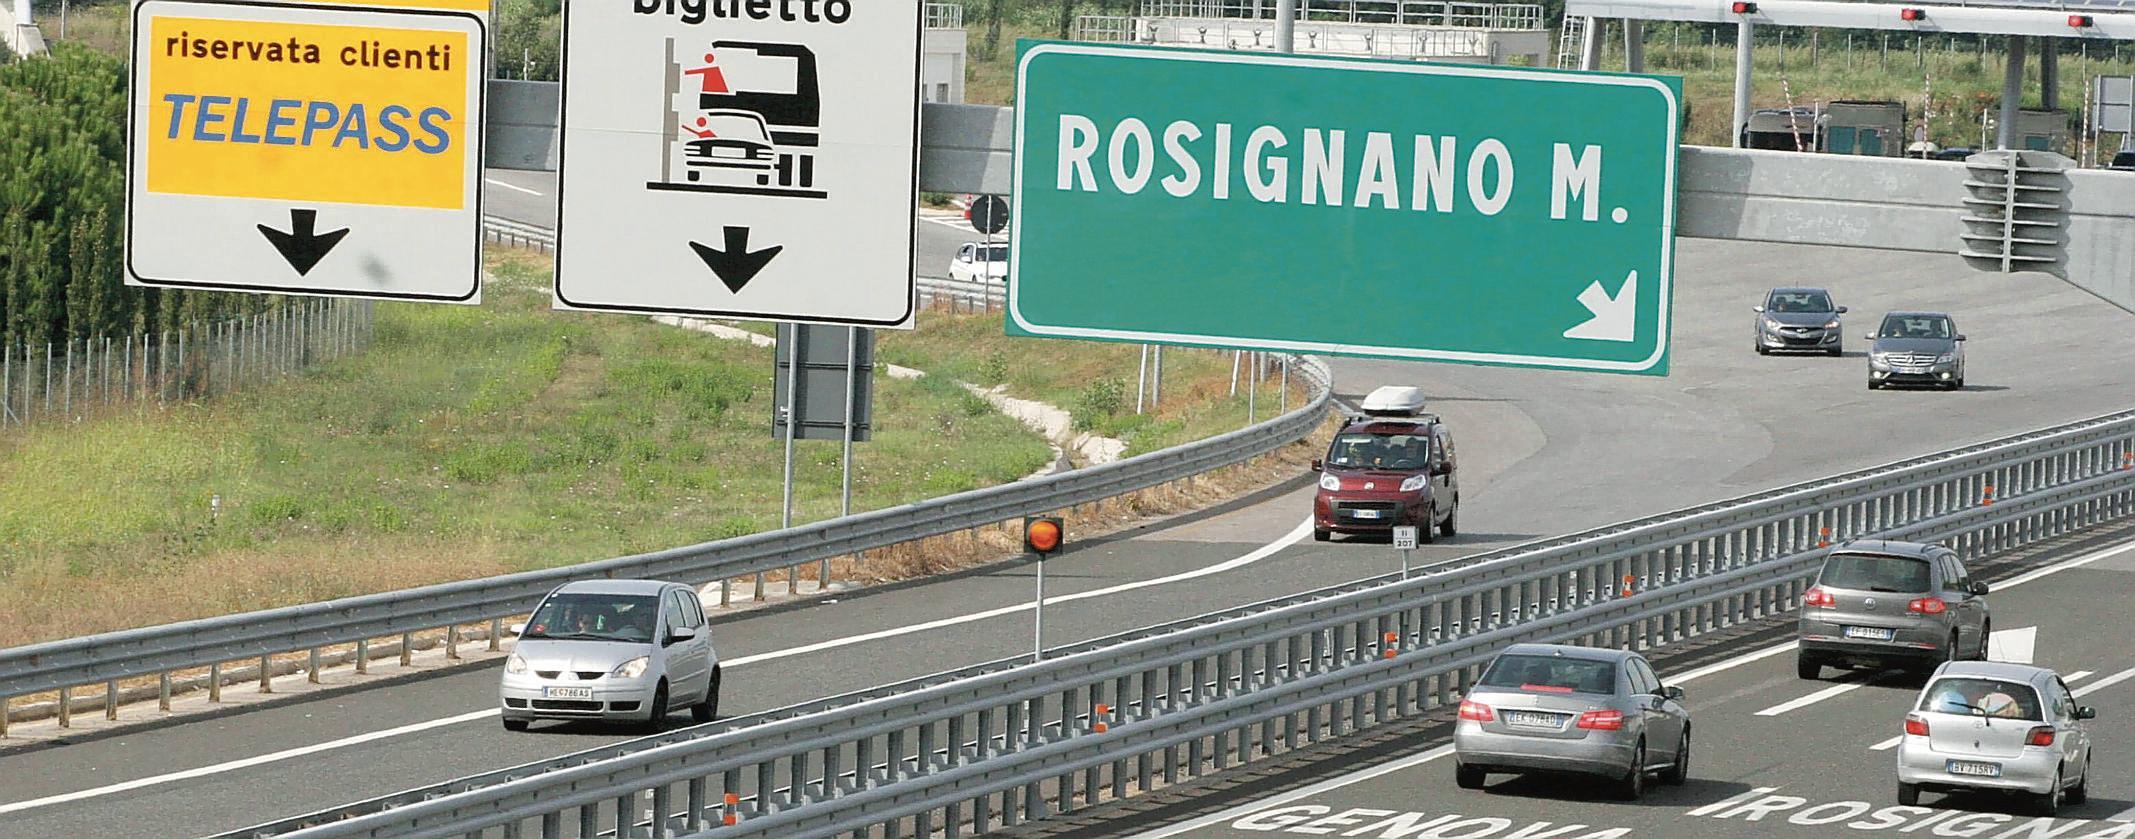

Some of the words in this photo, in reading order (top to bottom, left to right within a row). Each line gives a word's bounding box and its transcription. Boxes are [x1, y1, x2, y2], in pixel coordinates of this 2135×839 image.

[166, 31, 321, 64] riservata
[340, 40, 451, 71] clienti
[163, 93, 453, 154] TELEPASS
[1057, 114, 1514, 216] ROSIGNANO
[1550, 143, 1629, 224] M.
